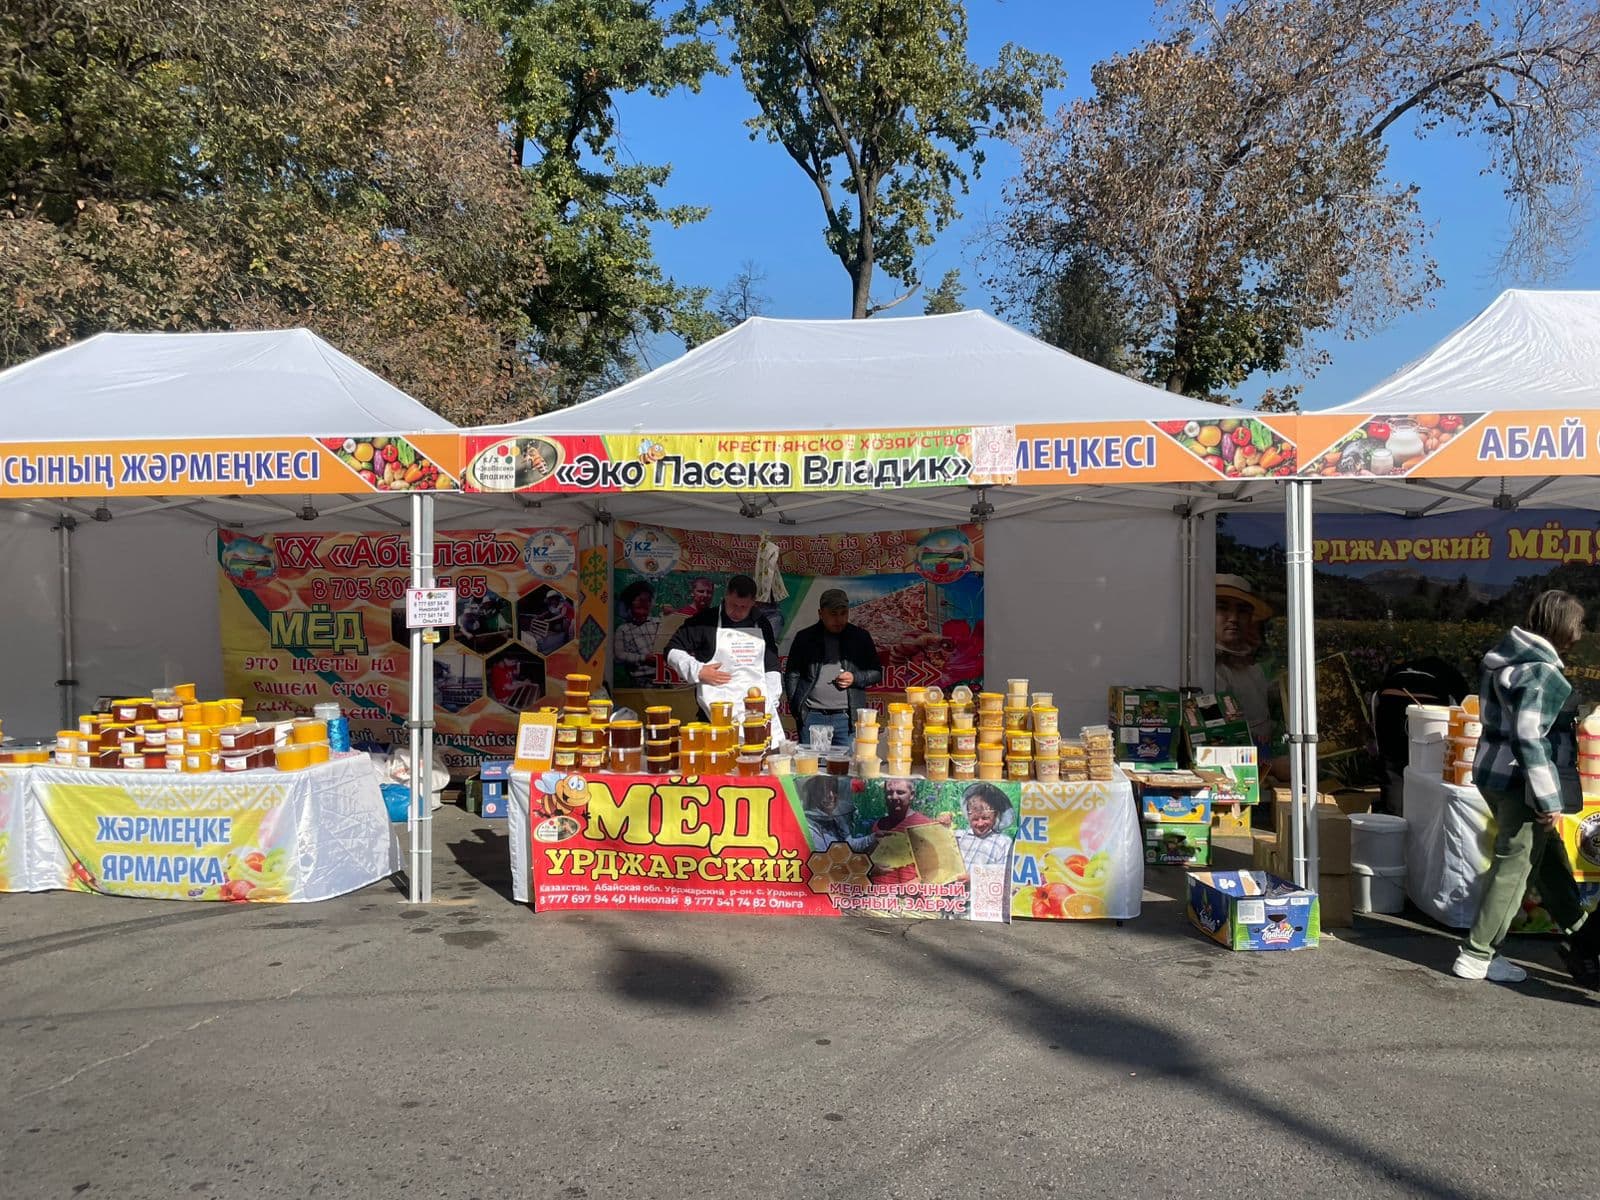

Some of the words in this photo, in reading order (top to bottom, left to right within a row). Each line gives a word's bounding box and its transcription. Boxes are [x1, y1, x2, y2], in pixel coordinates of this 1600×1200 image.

[860, 433, 971, 450] ХОЗЯЙСТВО
[1479, 419, 1585, 459] АБАЙ
[121, 452, 319, 487] ЖӘРМЕҢКЕСІ
[556, 455, 643, 486] «Эко
[654, 455, 791, 486] Пасека
[803, 455, 972, 487] Владик»
[274, 536, 325, 568] КХ
[1312, 532, 1491, 564] РДЖАРСКИЙ
[312, 578, 327, 599] 8
[330, 577, 372, 599] 705
[458, 575, 486, 598] 85
[270, 604, 369, 655] МЁД
[583, 775, 780, 857] МЁД
[97, 817, 232, 847] ЖӘРМЕҢКЕ
[102, 856, 225, 885] ЯРМАРКА
[545, 850, 803, 883] УРДЖАРСКИЙ
[548, 894, 569, 904] 777
[572, 894, 591, 904] 697
[594, 894, 608, 904] 94
[611, 894, 626, 904] 40
[629, 893, 678, 905] Николай
[695, 896, 713, 906] 777
[717, 897, 734, 907] 541
[738, 897, 750, 907] 74
[753, 898, 766, 908] 82
[769, 898, 804, 908] Ольга
[595, 883, 640, 892] Абайская
[665, 885, 725, 896] Урджарский
[829, 883, 864, 896] МЕД
[867, 882, 969, 898] ЦВЕТОЧНЫЙ,
[832, 896, 901, 911] ГОРНЫЙ,
[904, 899, 966, 912] ЗАБРУС
